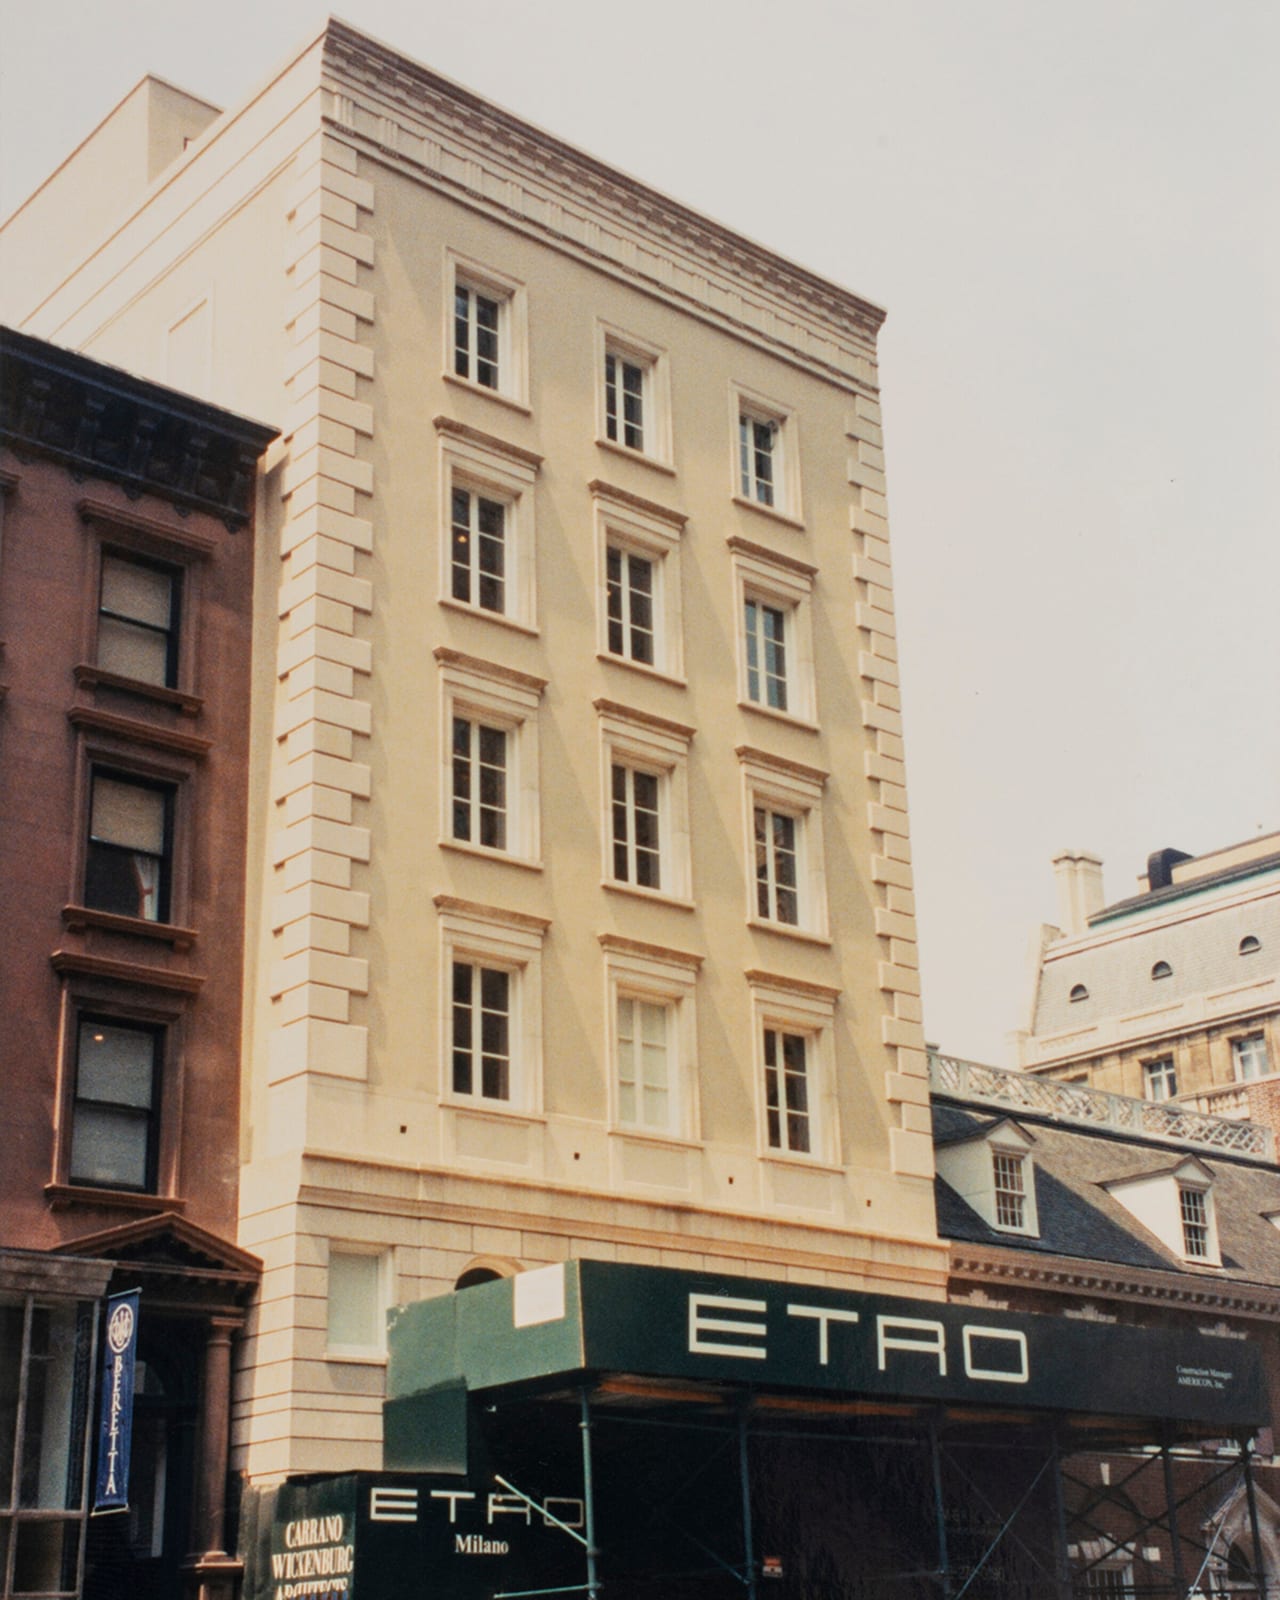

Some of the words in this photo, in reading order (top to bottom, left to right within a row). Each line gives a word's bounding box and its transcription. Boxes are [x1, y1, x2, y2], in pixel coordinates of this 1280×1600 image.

[689, 1292, 1029, 1383] ETRO
[105, 1355, 123, 1495] BERETTA
[370, 1487, 584, 1527] ETRO
[285, 1514, 343, 1548] CARRANO
[454, 1534, 509, 1554] Milano
[272, 1544, 354, 1579] WICKENBURG
